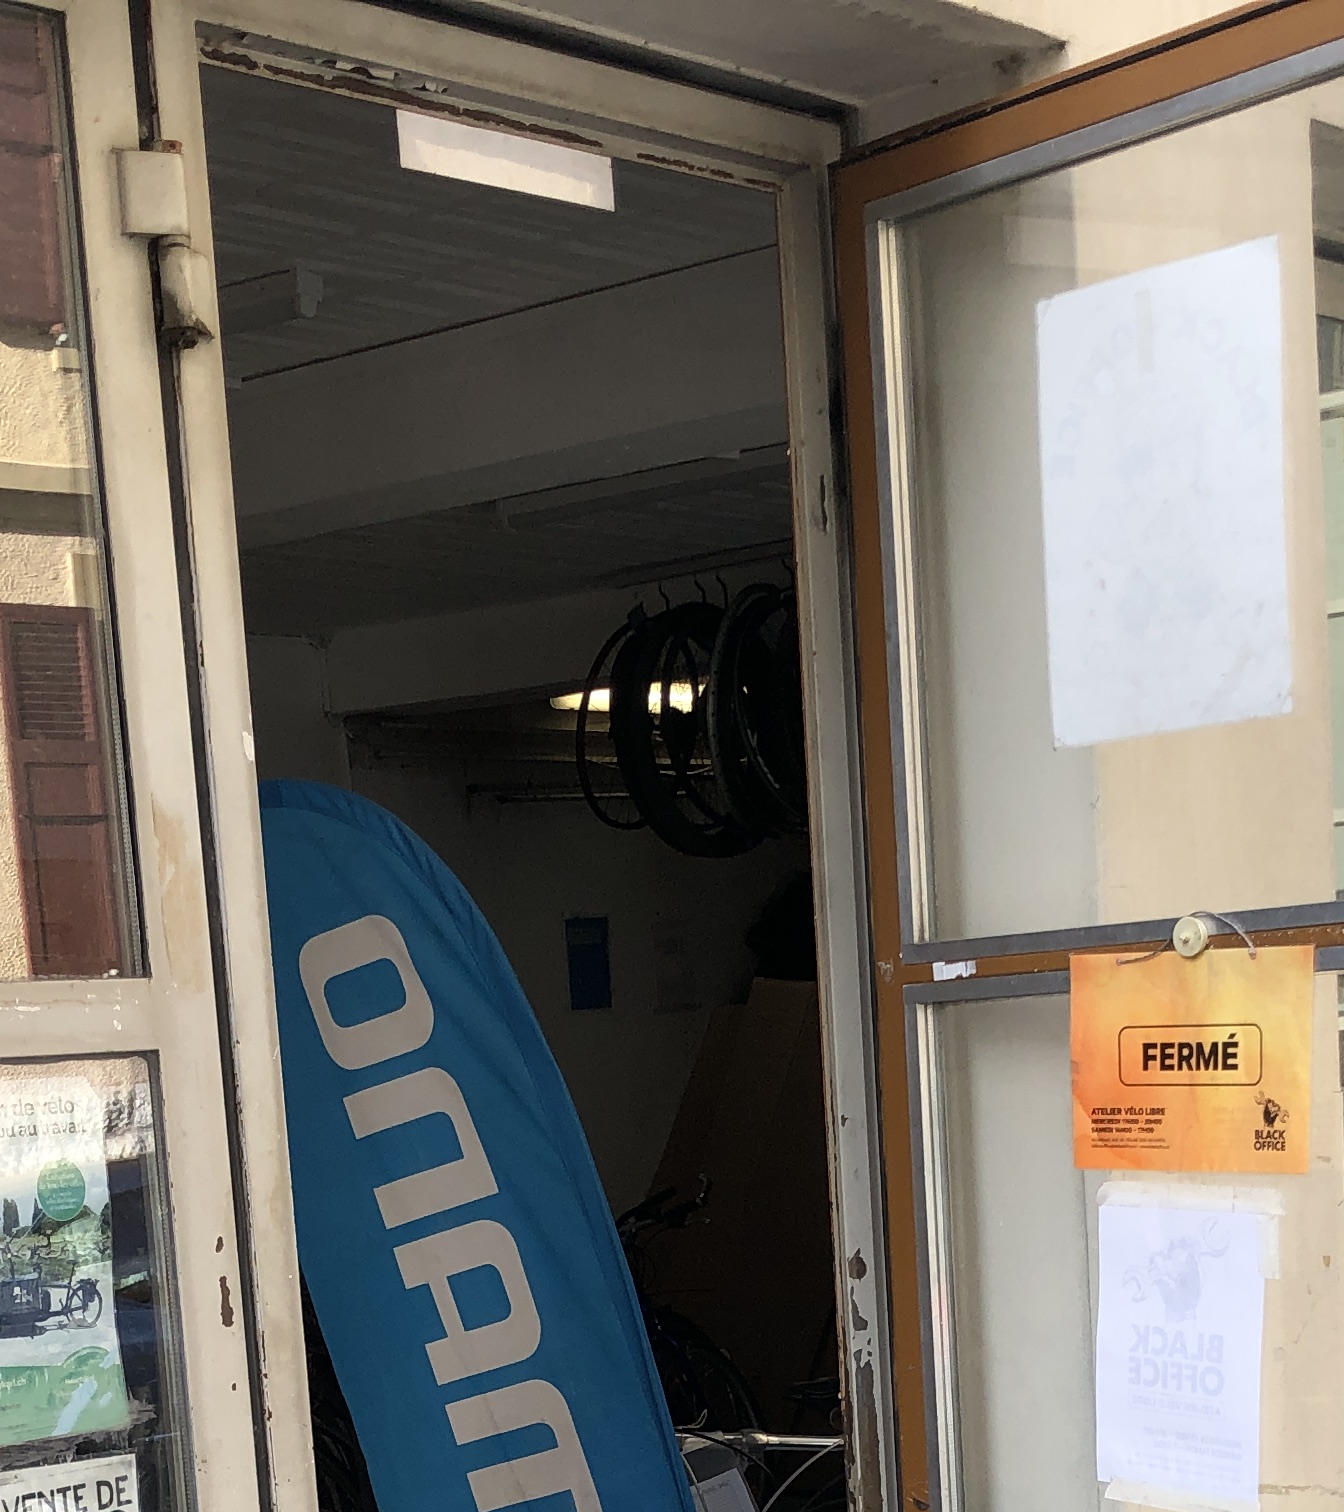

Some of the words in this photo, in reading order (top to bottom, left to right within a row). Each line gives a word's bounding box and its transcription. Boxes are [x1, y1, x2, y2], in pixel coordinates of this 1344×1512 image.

[1141, 1032, 1240, 1072] FERMÉ
[1091, 1107, 1123, 1116] ATELIER
[1254, 1129, 1286, 1142] BLACK
[1253, 1140, 1287, 1152] OFFICE
[95, 1474, 133, 1511] DE
